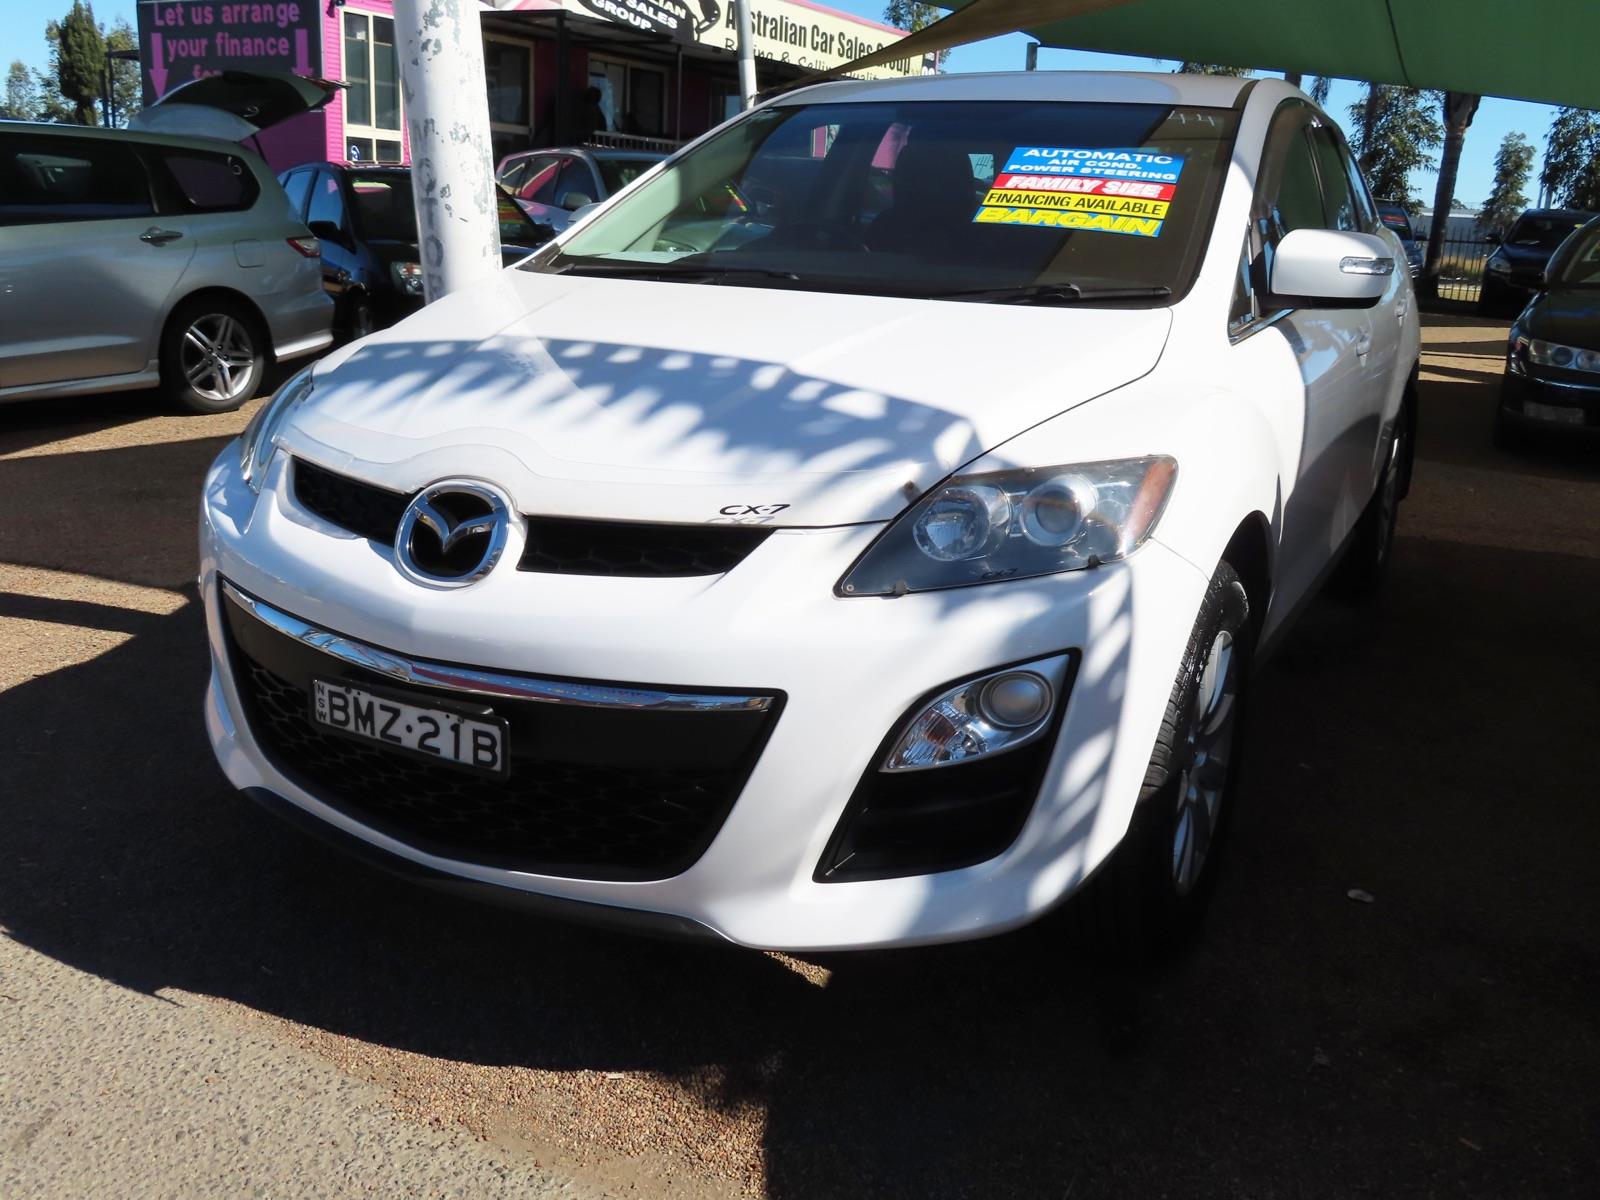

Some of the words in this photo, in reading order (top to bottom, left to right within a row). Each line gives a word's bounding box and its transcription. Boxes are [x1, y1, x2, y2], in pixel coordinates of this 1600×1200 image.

[154, 3, 184, 26] Let
[191, 6, 213, 25] us
[222, 2, 299, 27] arrange
[626, 0, 678, 29] SALES
[725, 1, 807, 48] Astralian
[811, 24, 835, 53] Car
[167, 36, 208, 62] your
[216, 32, 289, 57] finance
[1024, 149, 1173, 164] AUTOMATIC
[1048, 158, 1080, 166] AIR
[1085, 160, 1142, 170] COND.
[1008, 164, 1074, 173] POWER
[1079, 168, 1177, 181] STEERING
[1004, 176, 1103, 193] FAMILY
[1101, 180, 1164, 198] SIZE
[986, 192, 1071, 207] FINANCING
[1074, 197, 1163, 215] AVAILABLE
[974, 207, 1162, 236] BARGAIN
[719, 503, 791, 516] CX-7
[317, 684, 327, 721] NSW
